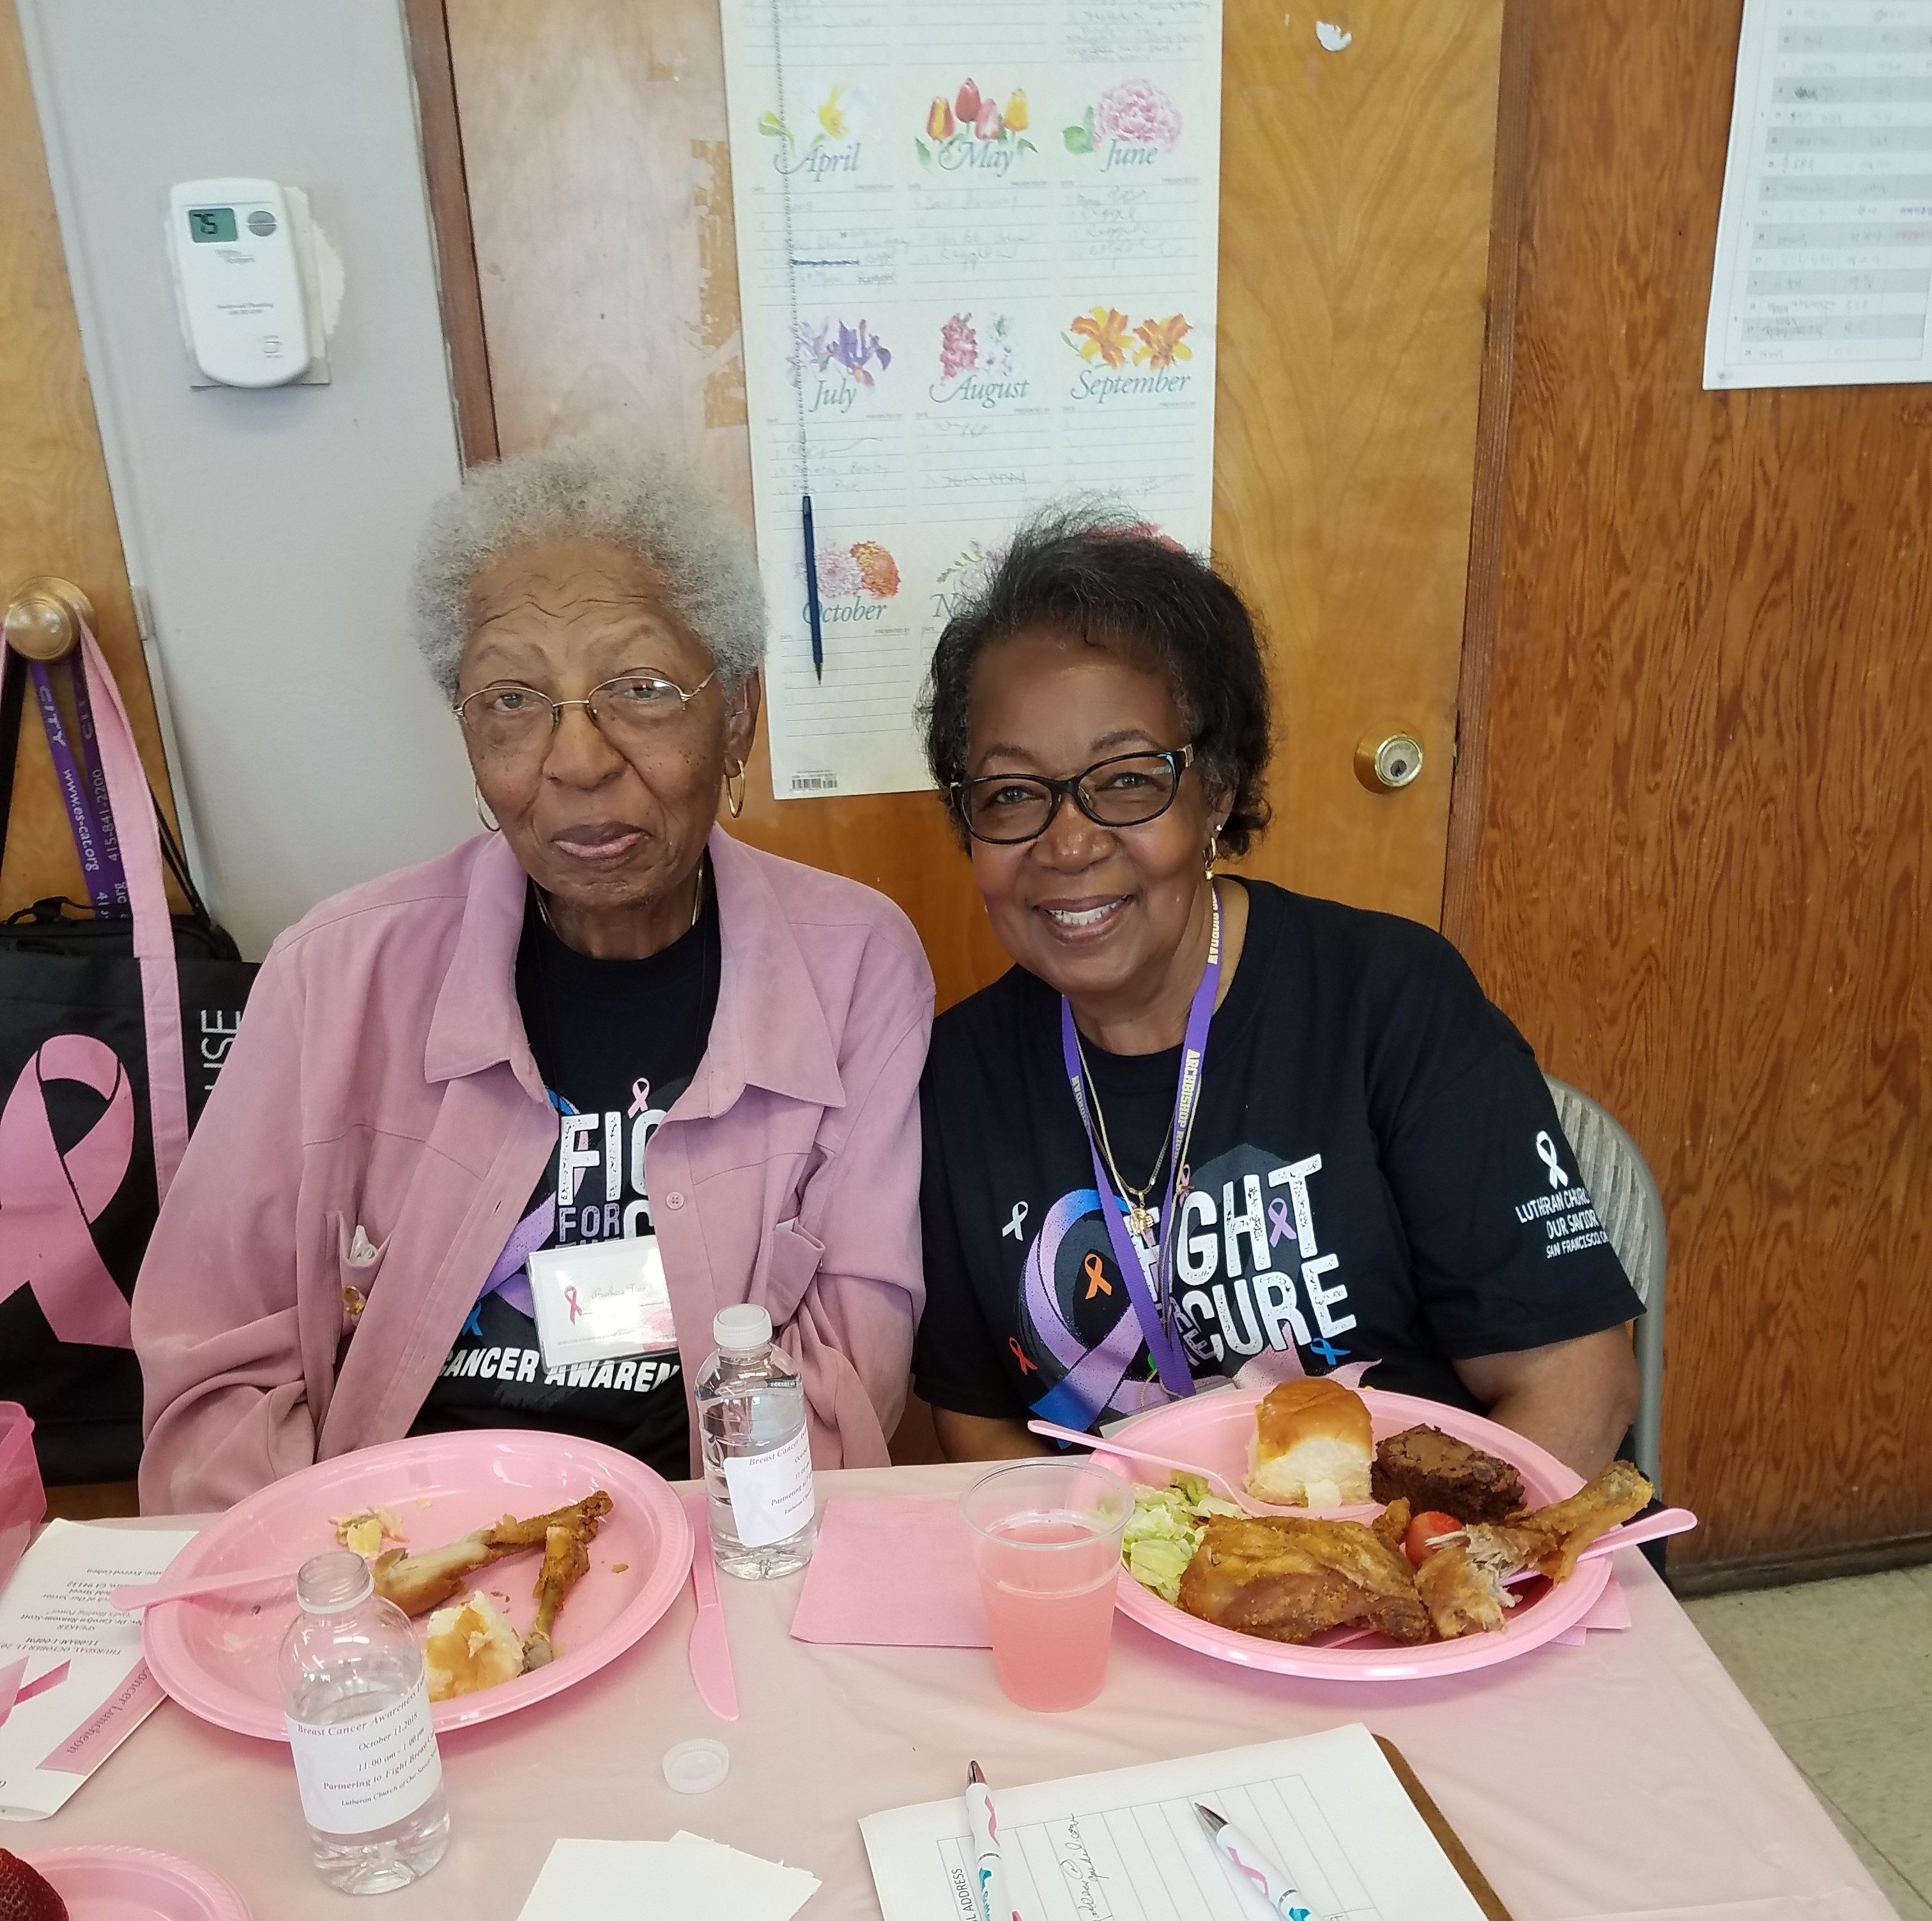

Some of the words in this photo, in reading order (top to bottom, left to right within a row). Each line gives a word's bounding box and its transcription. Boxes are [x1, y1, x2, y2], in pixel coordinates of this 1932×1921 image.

[774, 143, 861, 181] April
[938, 142, 1015, 177] May
[1101, 139, 1159, 172] June
[192, 213, 218, 235] 75
[810, 379, 857, 413] July
[930, 374, 1030, 408] August
[1071, 367, 1191, 405] September
[802, 596, 887, 624] October
[39, 684, 66, 747] CITY
[1177, 1049, 1201, 1129] ARCHBISHOP
[558, 1203, 620, 1243] FOR
[1546, 1216, 1569, 1240] OUR
[1567, 1209, 1600, 1234] SAVIOR
[1546, 1242, 1561, 1260] SAN
[1181, 1253, 1357, 1358] CURE
[749, 1453, 775, 1466] Breast
[777, 1439, 799, 1457] Cancer
[771, 1485, 802, 1506] Partnering
[66, 1706, 123, 1754] Luncheon
[298, 1724, 325, 1736] Breast
[328, 1722, 367, 1736] Cancer
[371, 1692, 417, 1725] Awareness
[358, 1733, 391, 1751] October
[358, 1757, 382, 1772] 11:00
[384, 1752, 396, 1762] am
[403, 1736, 417, 1751] 1:00
[323, 1778, 371, 1791] Partnering
[373, 1774, 382, 1784] to
[385, 1759, 408, 1778] Fight
[409, 1740, 430, 1765] Breast
[341, 1794, 372, 1807] Lutheran
[373, 1784, 399, 1801] Church
[399, 1779, 406, 1789] of
[951, 1867, 975, 1912] ADDRESS
